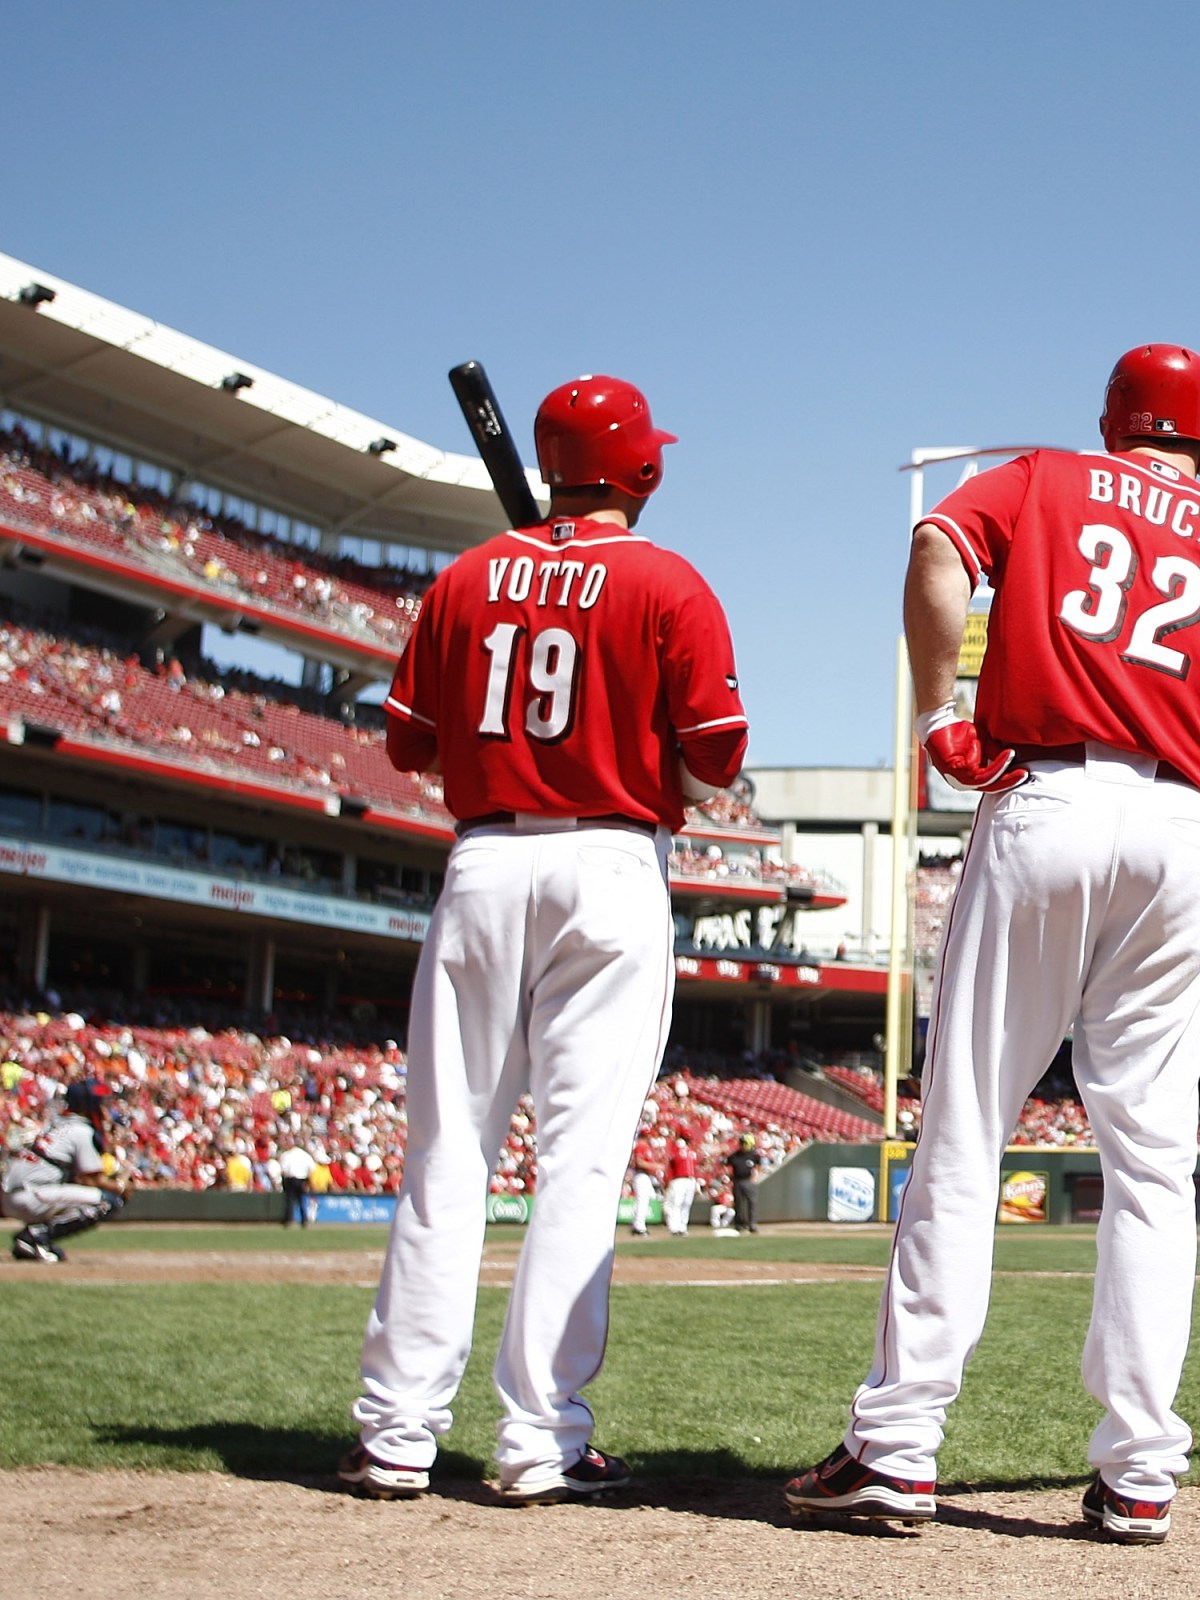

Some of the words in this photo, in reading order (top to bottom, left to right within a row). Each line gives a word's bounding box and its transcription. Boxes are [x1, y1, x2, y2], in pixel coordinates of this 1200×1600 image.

[1129, 412, 1152, 431] 32
[487, 556, 608, 611] VOTTO
[478, 622, 583, 747] 19
